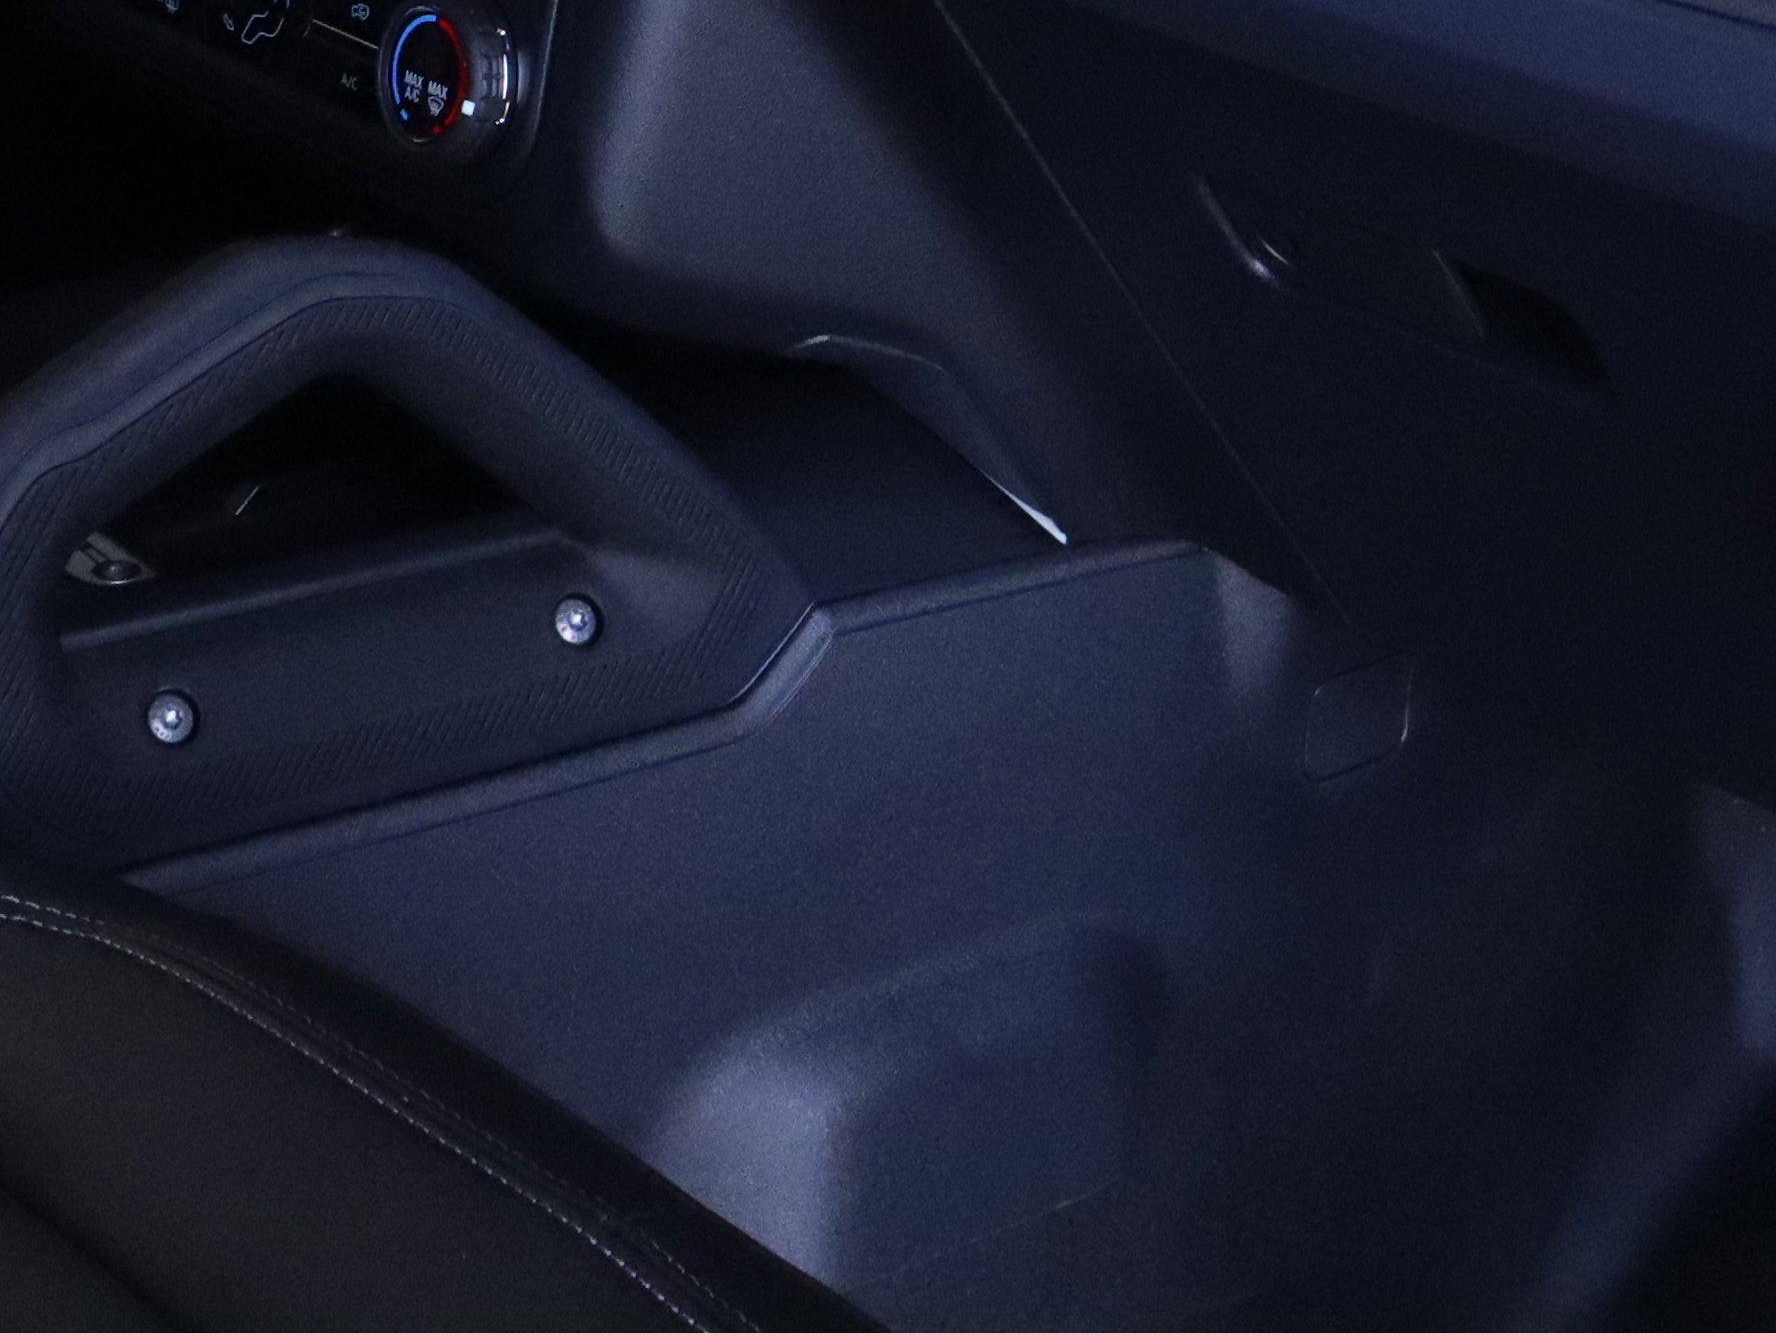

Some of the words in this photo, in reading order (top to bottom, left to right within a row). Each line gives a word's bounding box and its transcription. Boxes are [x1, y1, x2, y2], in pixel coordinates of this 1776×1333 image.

[340, 72, 360, 91] A/C
[404, 69, 425, 89] MAX
[428, 79, 449, 99] MAX
[404, 86, 422, 104] A/C
